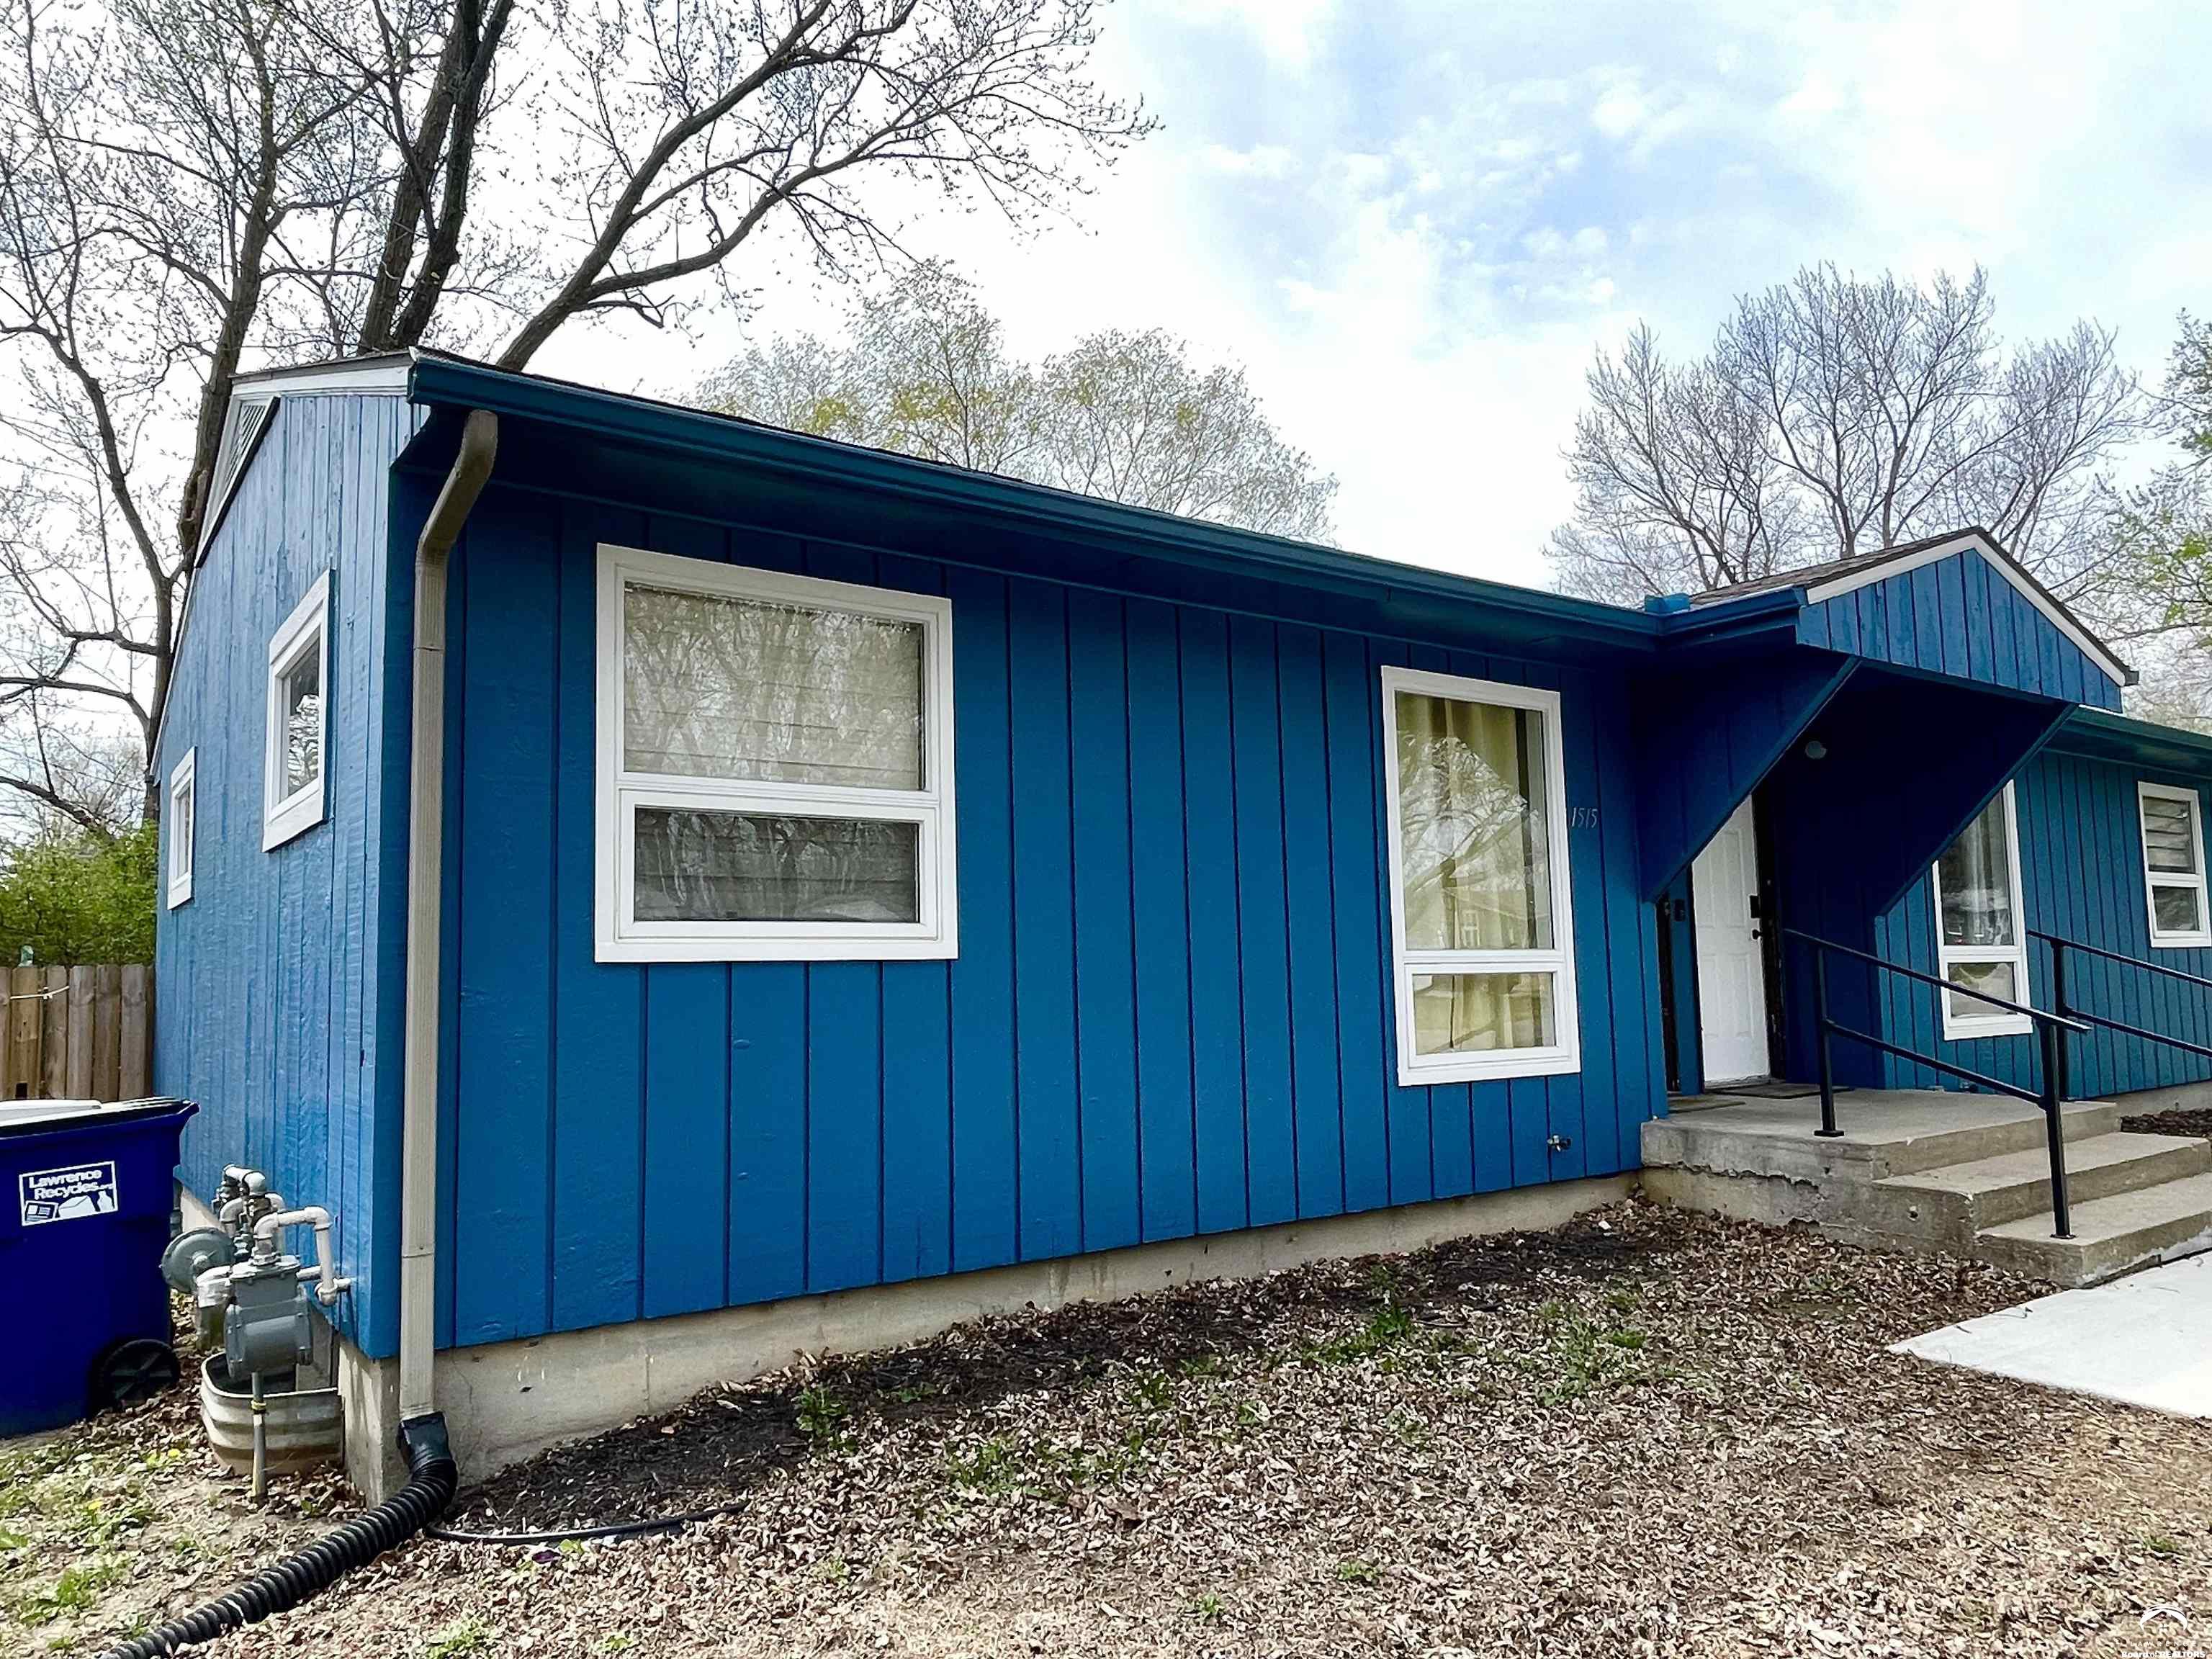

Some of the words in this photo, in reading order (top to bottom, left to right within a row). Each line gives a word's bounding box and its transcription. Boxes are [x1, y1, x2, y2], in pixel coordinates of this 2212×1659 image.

[1571, 807, 1598, 829] 1515
[29, 1170, 102, 1188] Lawrence
[34, 1182, 98, 1200] Recycles
